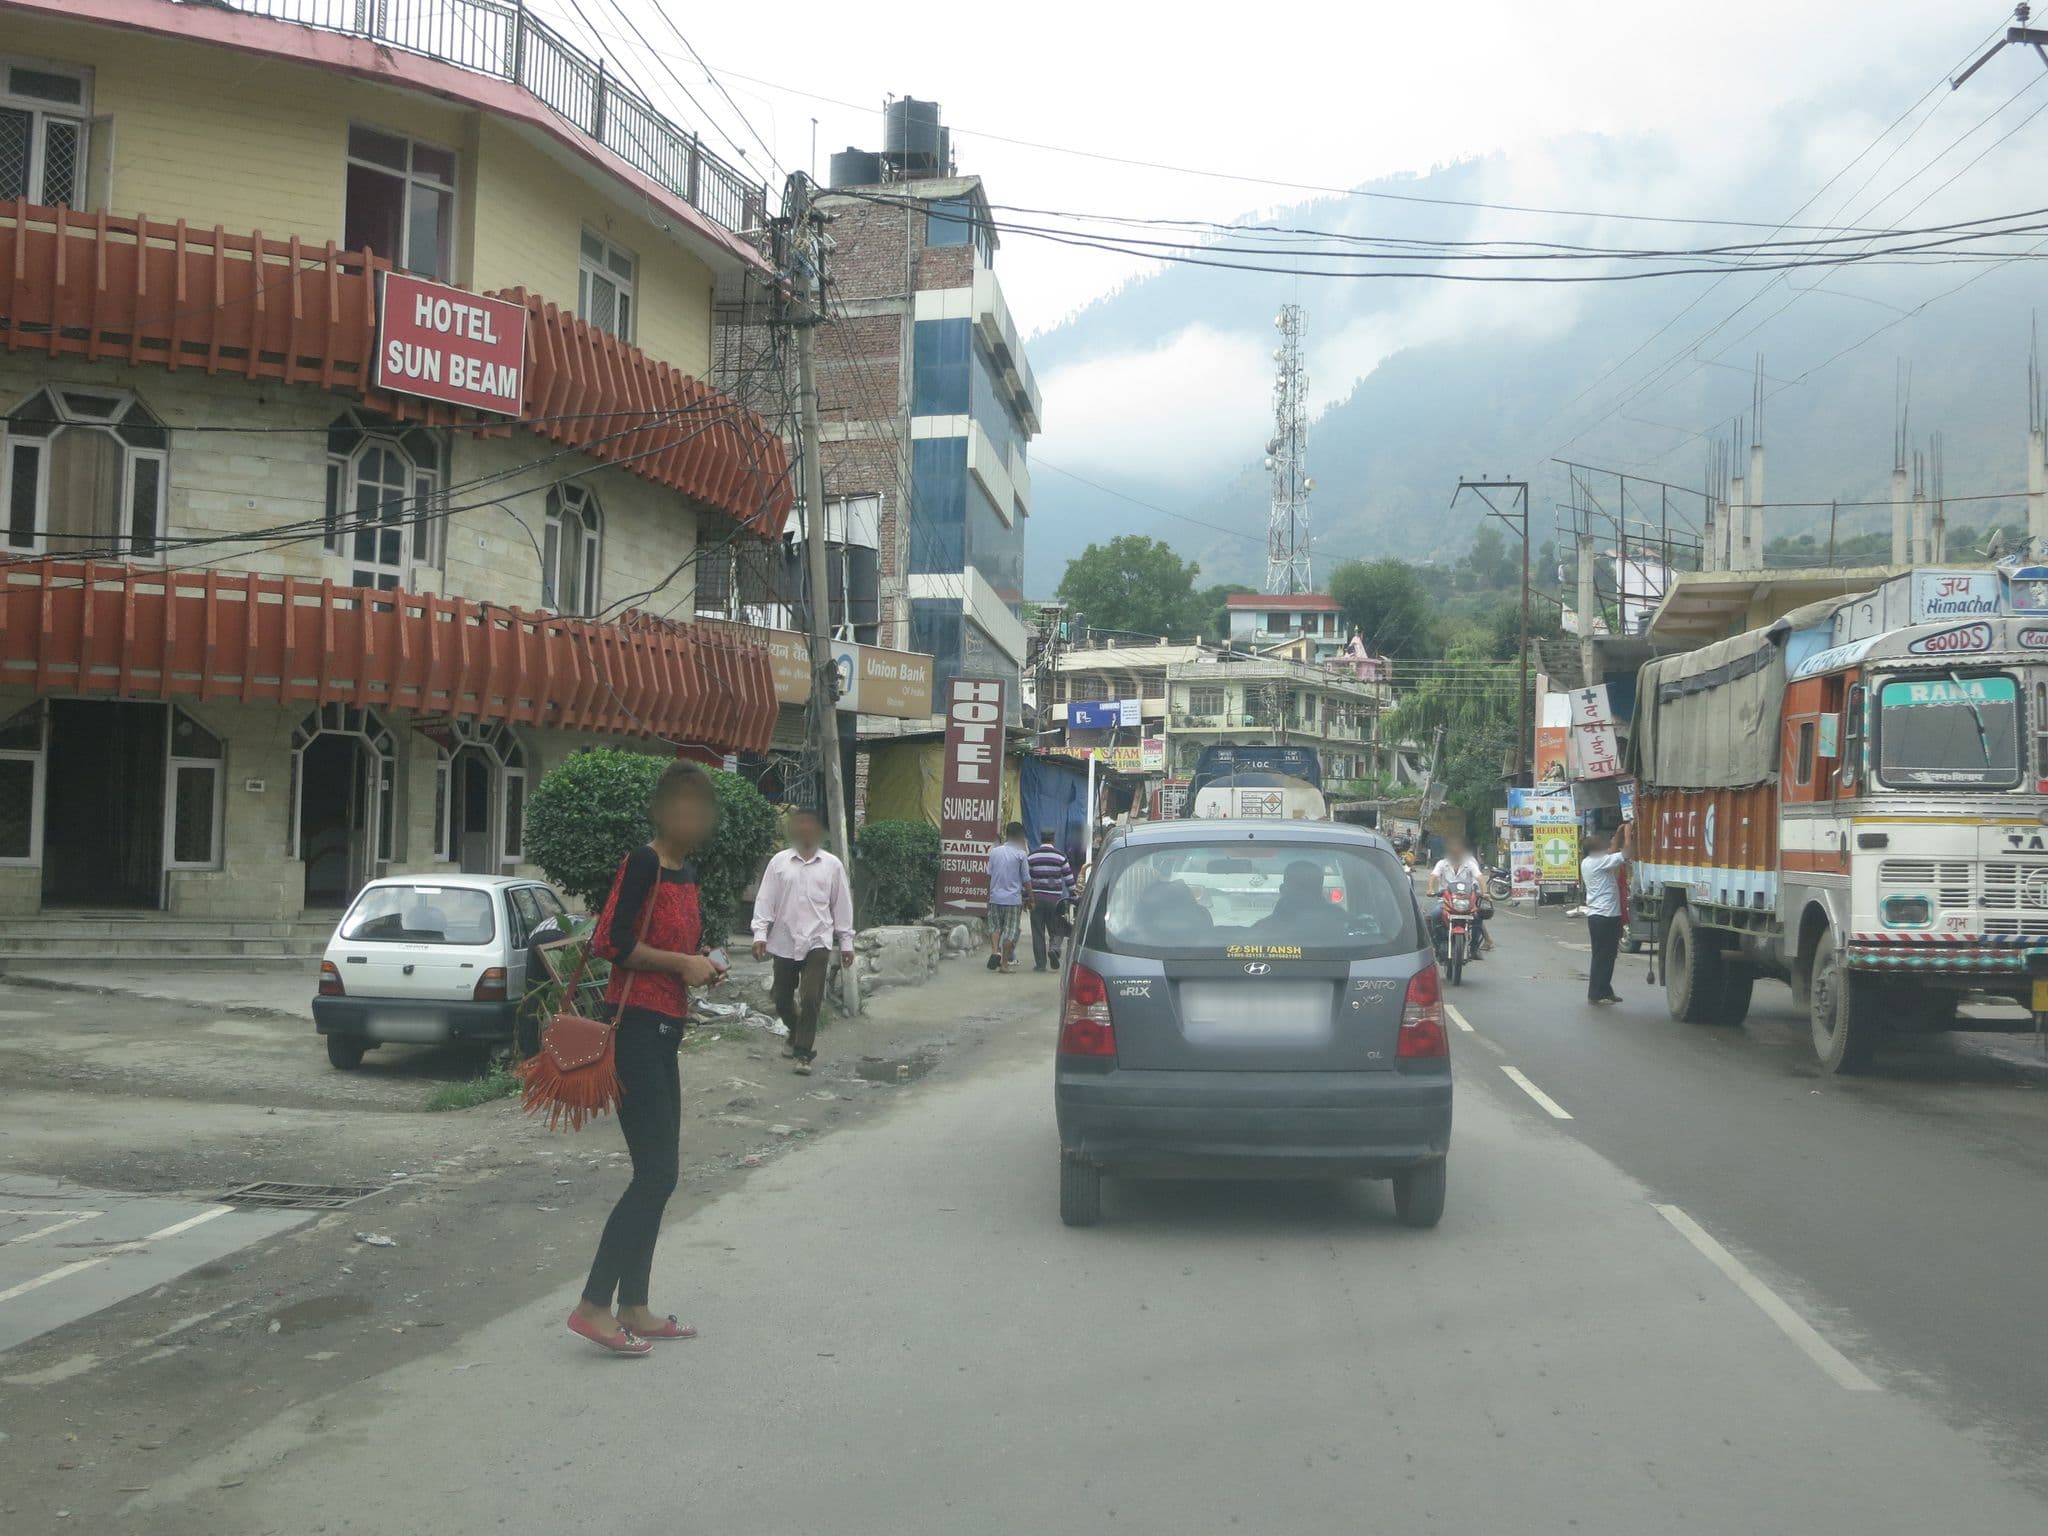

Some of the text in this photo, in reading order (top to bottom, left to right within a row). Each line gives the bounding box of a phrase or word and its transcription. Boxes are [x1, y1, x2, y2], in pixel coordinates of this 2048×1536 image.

[415, 294, 497, 345] HOTEL
[387, 340, 517, 400] SUN BEAM
[1936, 577, 1972, 597] जय
[1927, 594, 2000, 614] Himachal
[1925, 626, 1984, 651] GOODS
[867, 657, 926, 682] Union Bank
[952, 681, 1000, 785] HOTEL
[943, 797, 995, 822] SUNBEAM
[964, 829, 973, 839] &
[1535, 827, 1576, 835] MEDICINE
[943, 842, 992, 854] FAMILY
[941, 859, 990, 873] RESTAURAN
[1353, 980, 1397, 991] SANTRO
